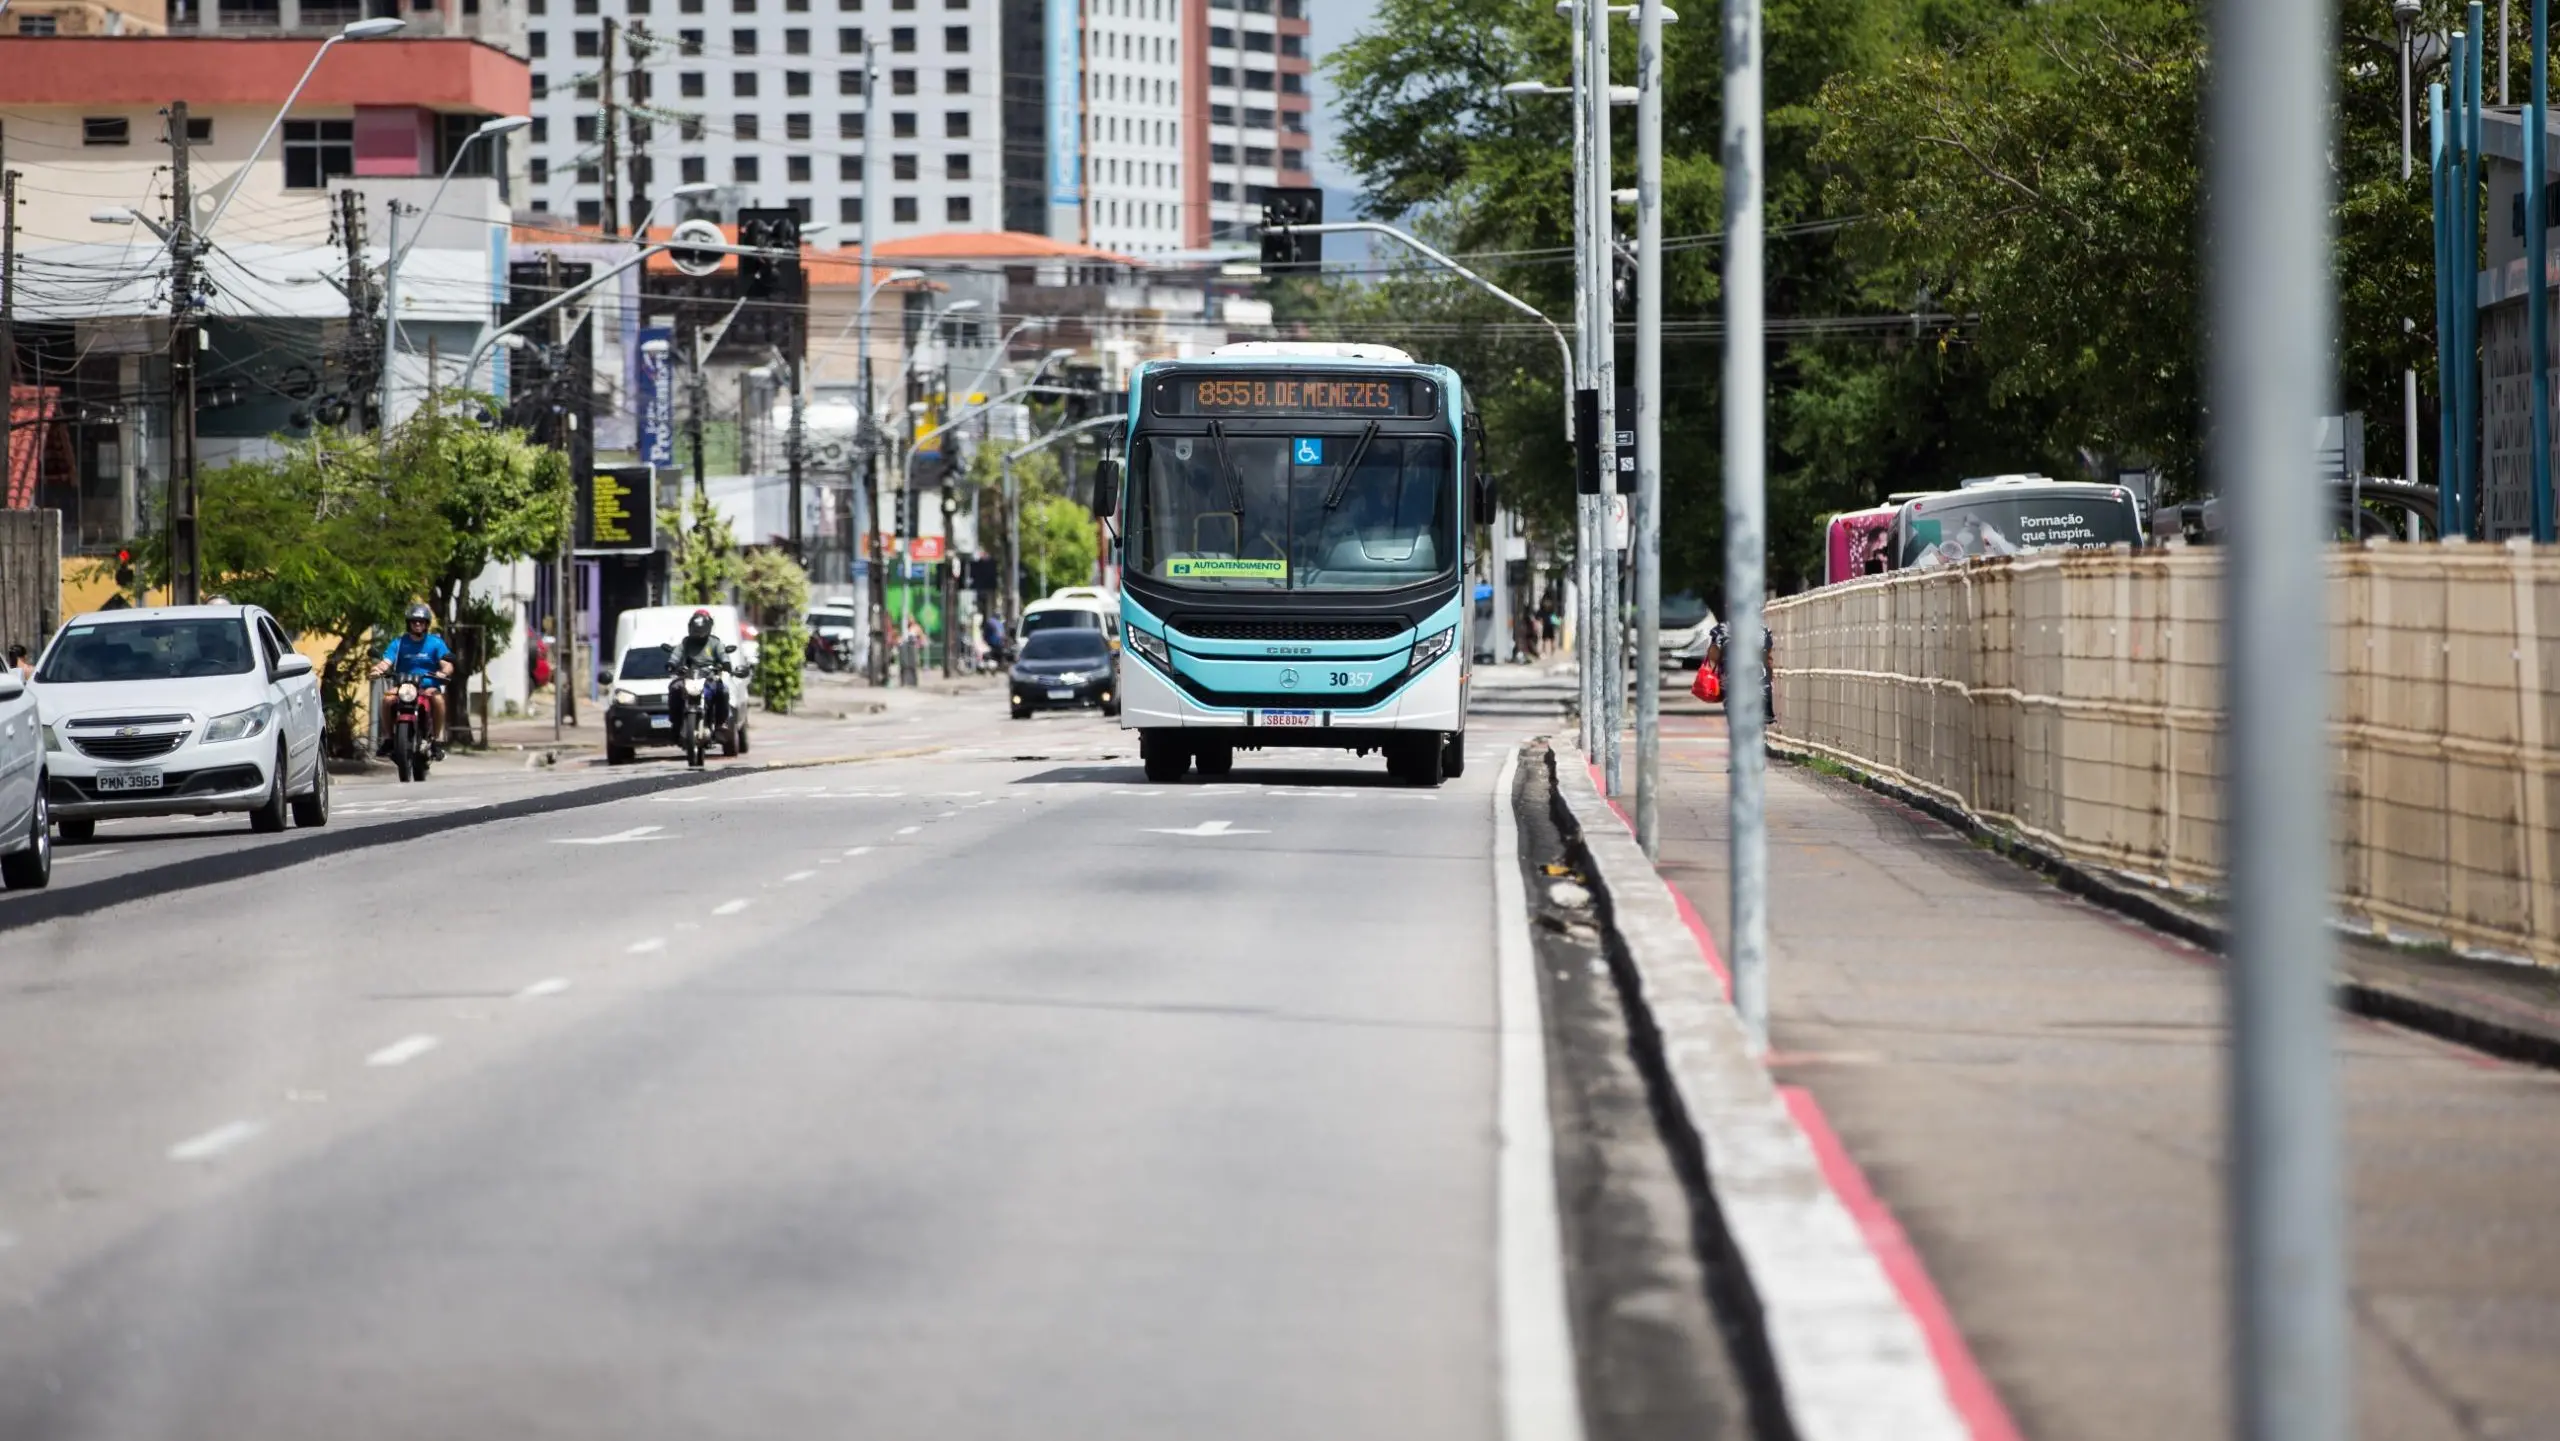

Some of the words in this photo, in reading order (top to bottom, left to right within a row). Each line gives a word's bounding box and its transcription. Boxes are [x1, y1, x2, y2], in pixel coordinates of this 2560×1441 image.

[1199, 381, 1250, 406] 855
[1254, 381, 1271, 406] B.
[1275, 381, 1299, 406] DE
[1303, 382, 1390, 408] MENEZES
[2020, 513, 2084, 528] Formação
[2022, 531, 2046, 544] que
[2048, 528, 2094, 541] inspira.
[1193, 561, 1281, 571] AUTOATENDIMENTO
[1329, 672, 1374, 687] 30357
[1266, 715, 1310, 725] SBE8D47
